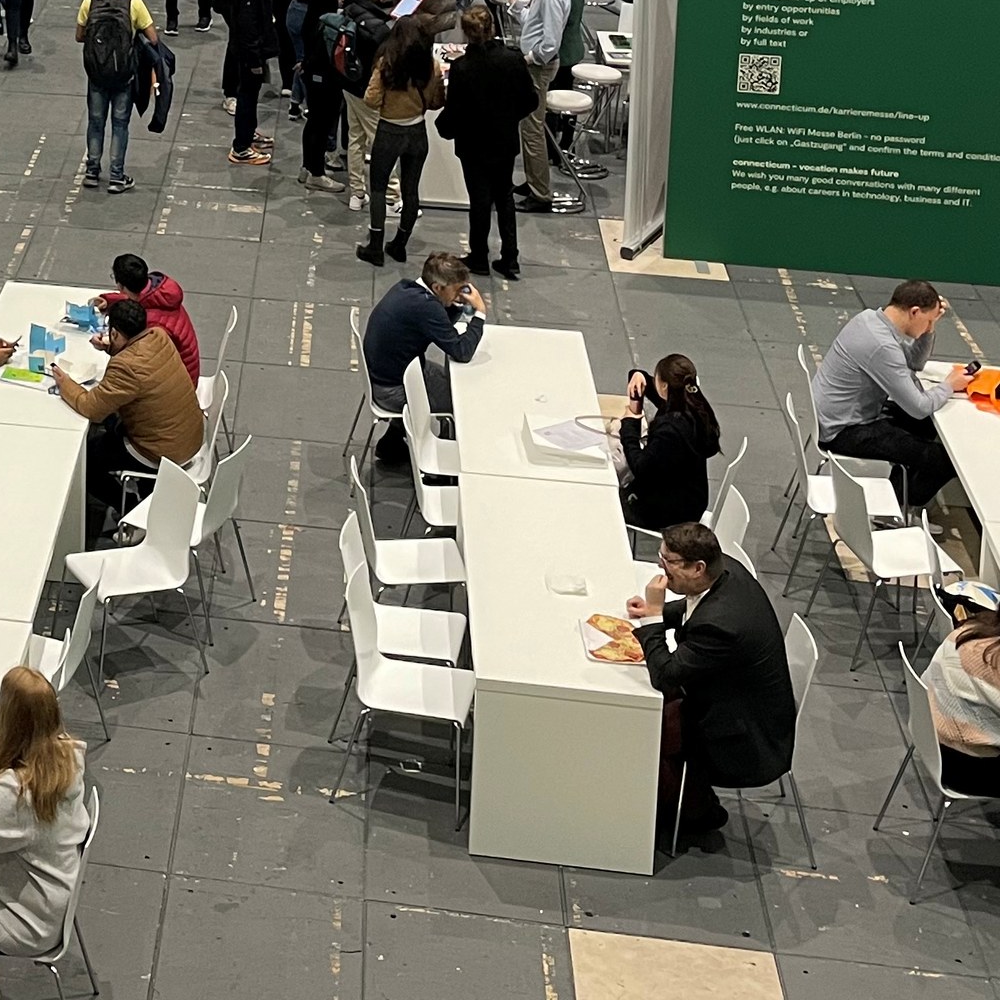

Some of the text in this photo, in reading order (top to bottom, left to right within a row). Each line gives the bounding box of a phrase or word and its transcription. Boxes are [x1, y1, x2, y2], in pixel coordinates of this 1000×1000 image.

[743, 2, 840, 16] by entry opportunities
[742, 14, 753, 23] by
[755, 15, 779, 24] fields
[793, 18, 814, 26] work
[741, 26, 752, 35] by
[754, 26, 797, 37] industries
[740, 38, 787, 48] by full text
[736, 102, 930, 122] www.connecticum.de/karrieremesse/line-up
[735, 123, 754, 132] Free
[756, 125, 786, 135] WLAN:
[807, 128, 835, 138] Messe
[837, 130, 862, 140] Berlin
[884, 134, 926, 144] password
[734, 134, 753, 144] (just
[755, 136, 774, 145] click
[848, 144, 865, 152] and
[867, 146, 901, 155] confirm
[903, 148, 918, 156] the
[920, 149, 945, 158] terms
[947, 152, 964, 160] and
[733, 158, 791, 169] connecticum
[799, 164, 838, 173] vocation
[839, 166, 869, 175] makes
[870, 168, 900, 178] future
[732, 170, 746, 178] We
[768, 174, 784, 182] you
[786, 175, 810, 184] many
[812, 176, 834, 185] good
[835, 179, 895, 190] conversations
[897, 183, 916, 191] with
[918, 186, 942, 194] many
[943, 186, 981, 196] different
[781, 186, 806, 194] about
[808, 188, 840, 197] careers
[842, 189, 850, 197] in
[904, 194, 942, 205] business
[943, 198, 960, 206] and
